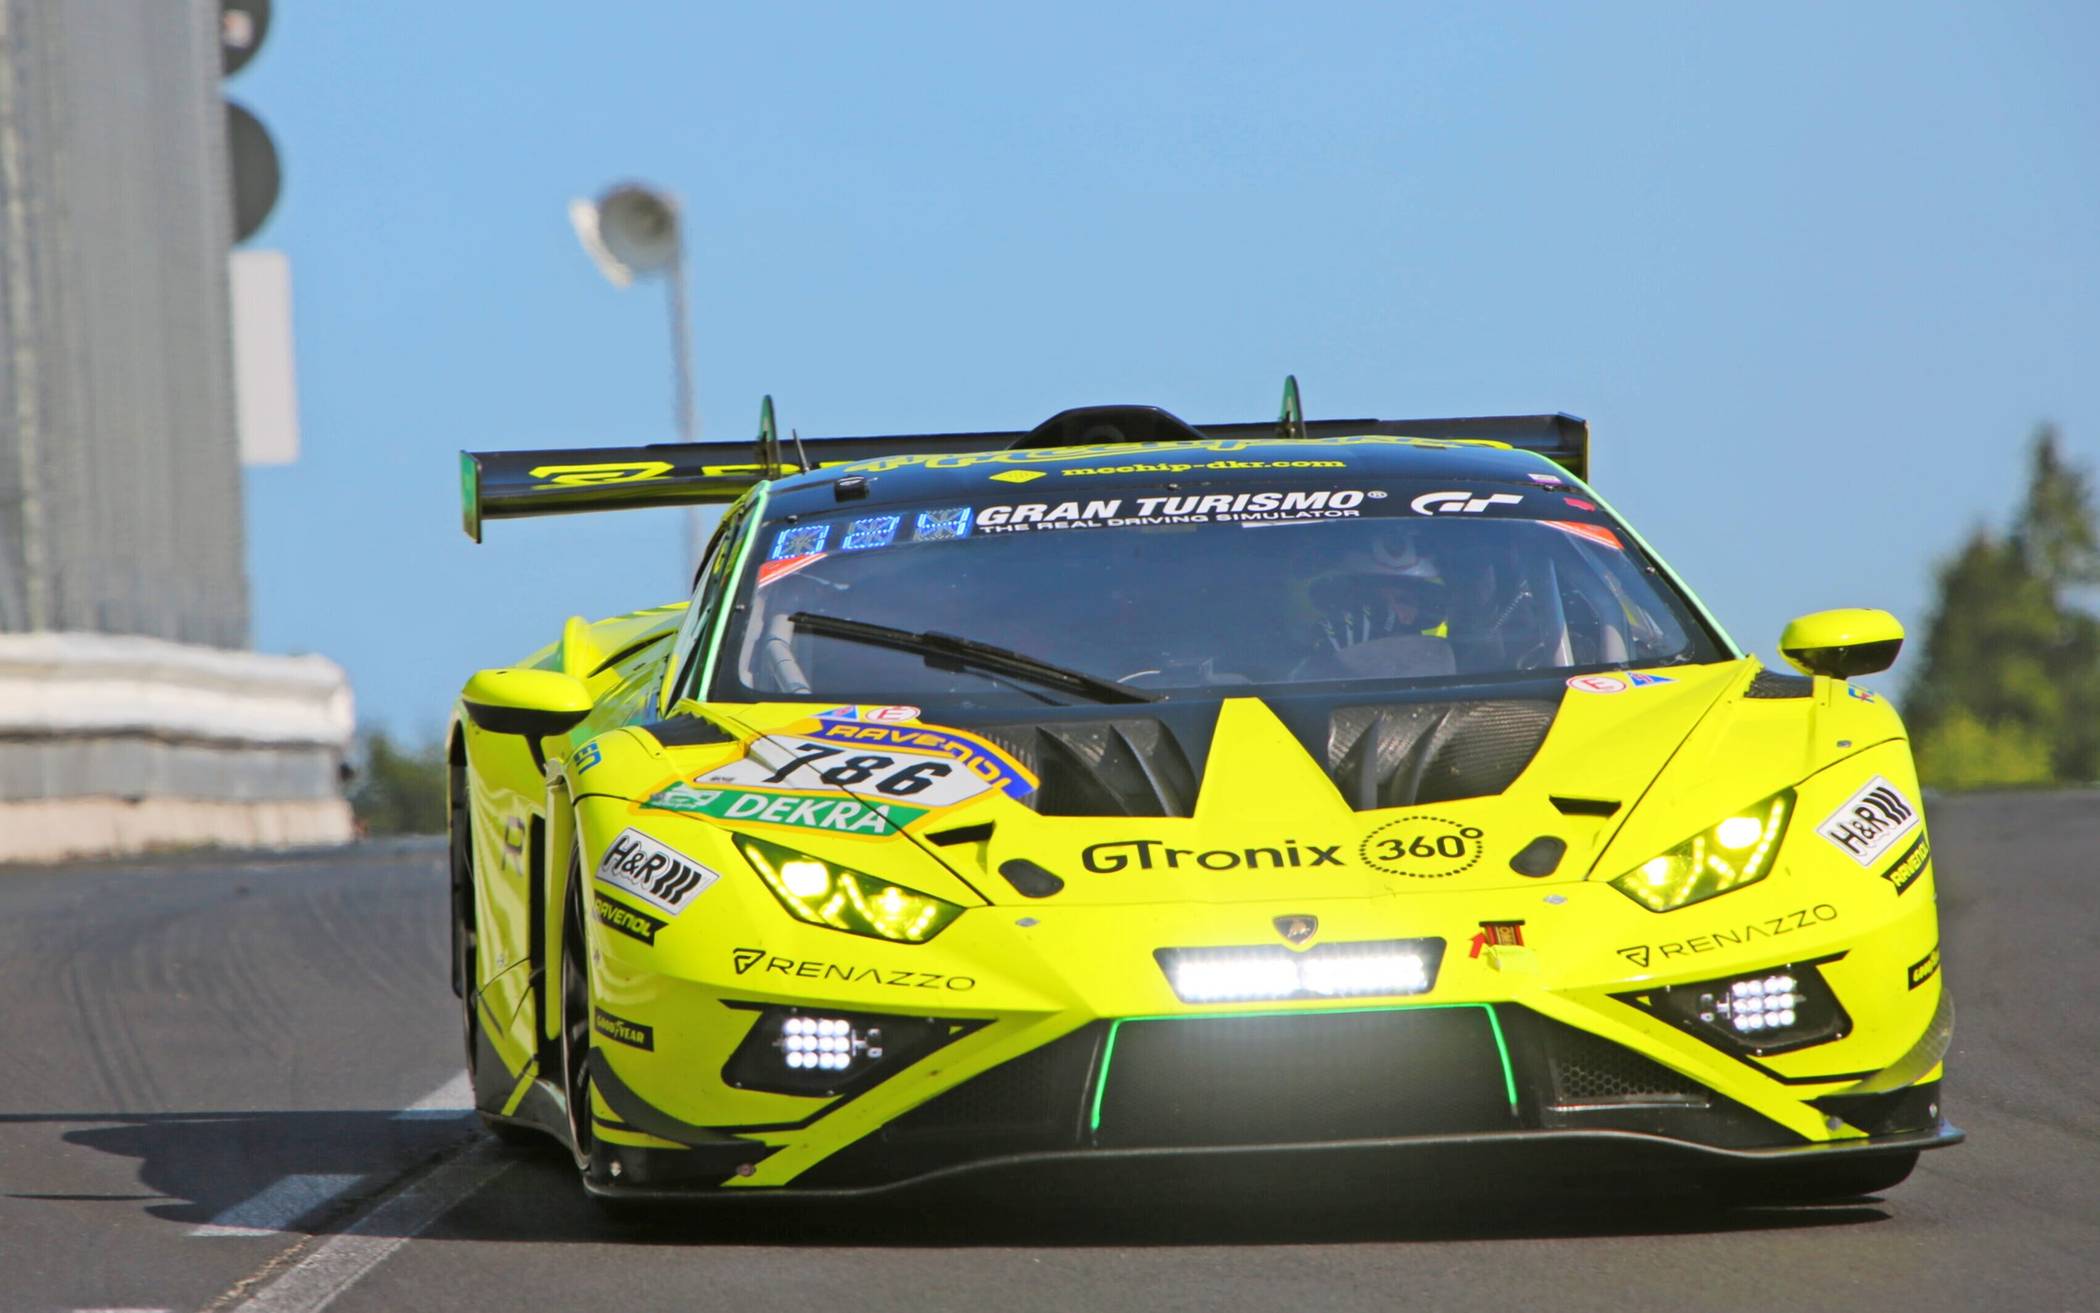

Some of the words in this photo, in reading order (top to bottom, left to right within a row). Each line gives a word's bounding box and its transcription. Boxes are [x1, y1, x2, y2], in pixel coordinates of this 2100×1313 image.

[1061, 458, 1347, 477] mcchip-dkr.com
[976, 499, 1123, 527] GRAN
[979, 523, 1030, 534] THE
[1036, 519, 1102, 530] REAL
[1107, 514, 1210, 527] DRIVING
[1217, 508, 1361, 522] SIMULATOR
[762, 743, 954, 797] 786
[827, 725, 1013, 788] RAVENOL
[723, 793, 891, 835] DEKRA
[1829, 805, 1890, 855] H&R
[602, 834, 669, 886] H&R
[1081, 839, 1347, 874] GTronix
[1659, 903, 1839, 959] RENAZZO
[766, 956, 977, 992] RENAZZO
